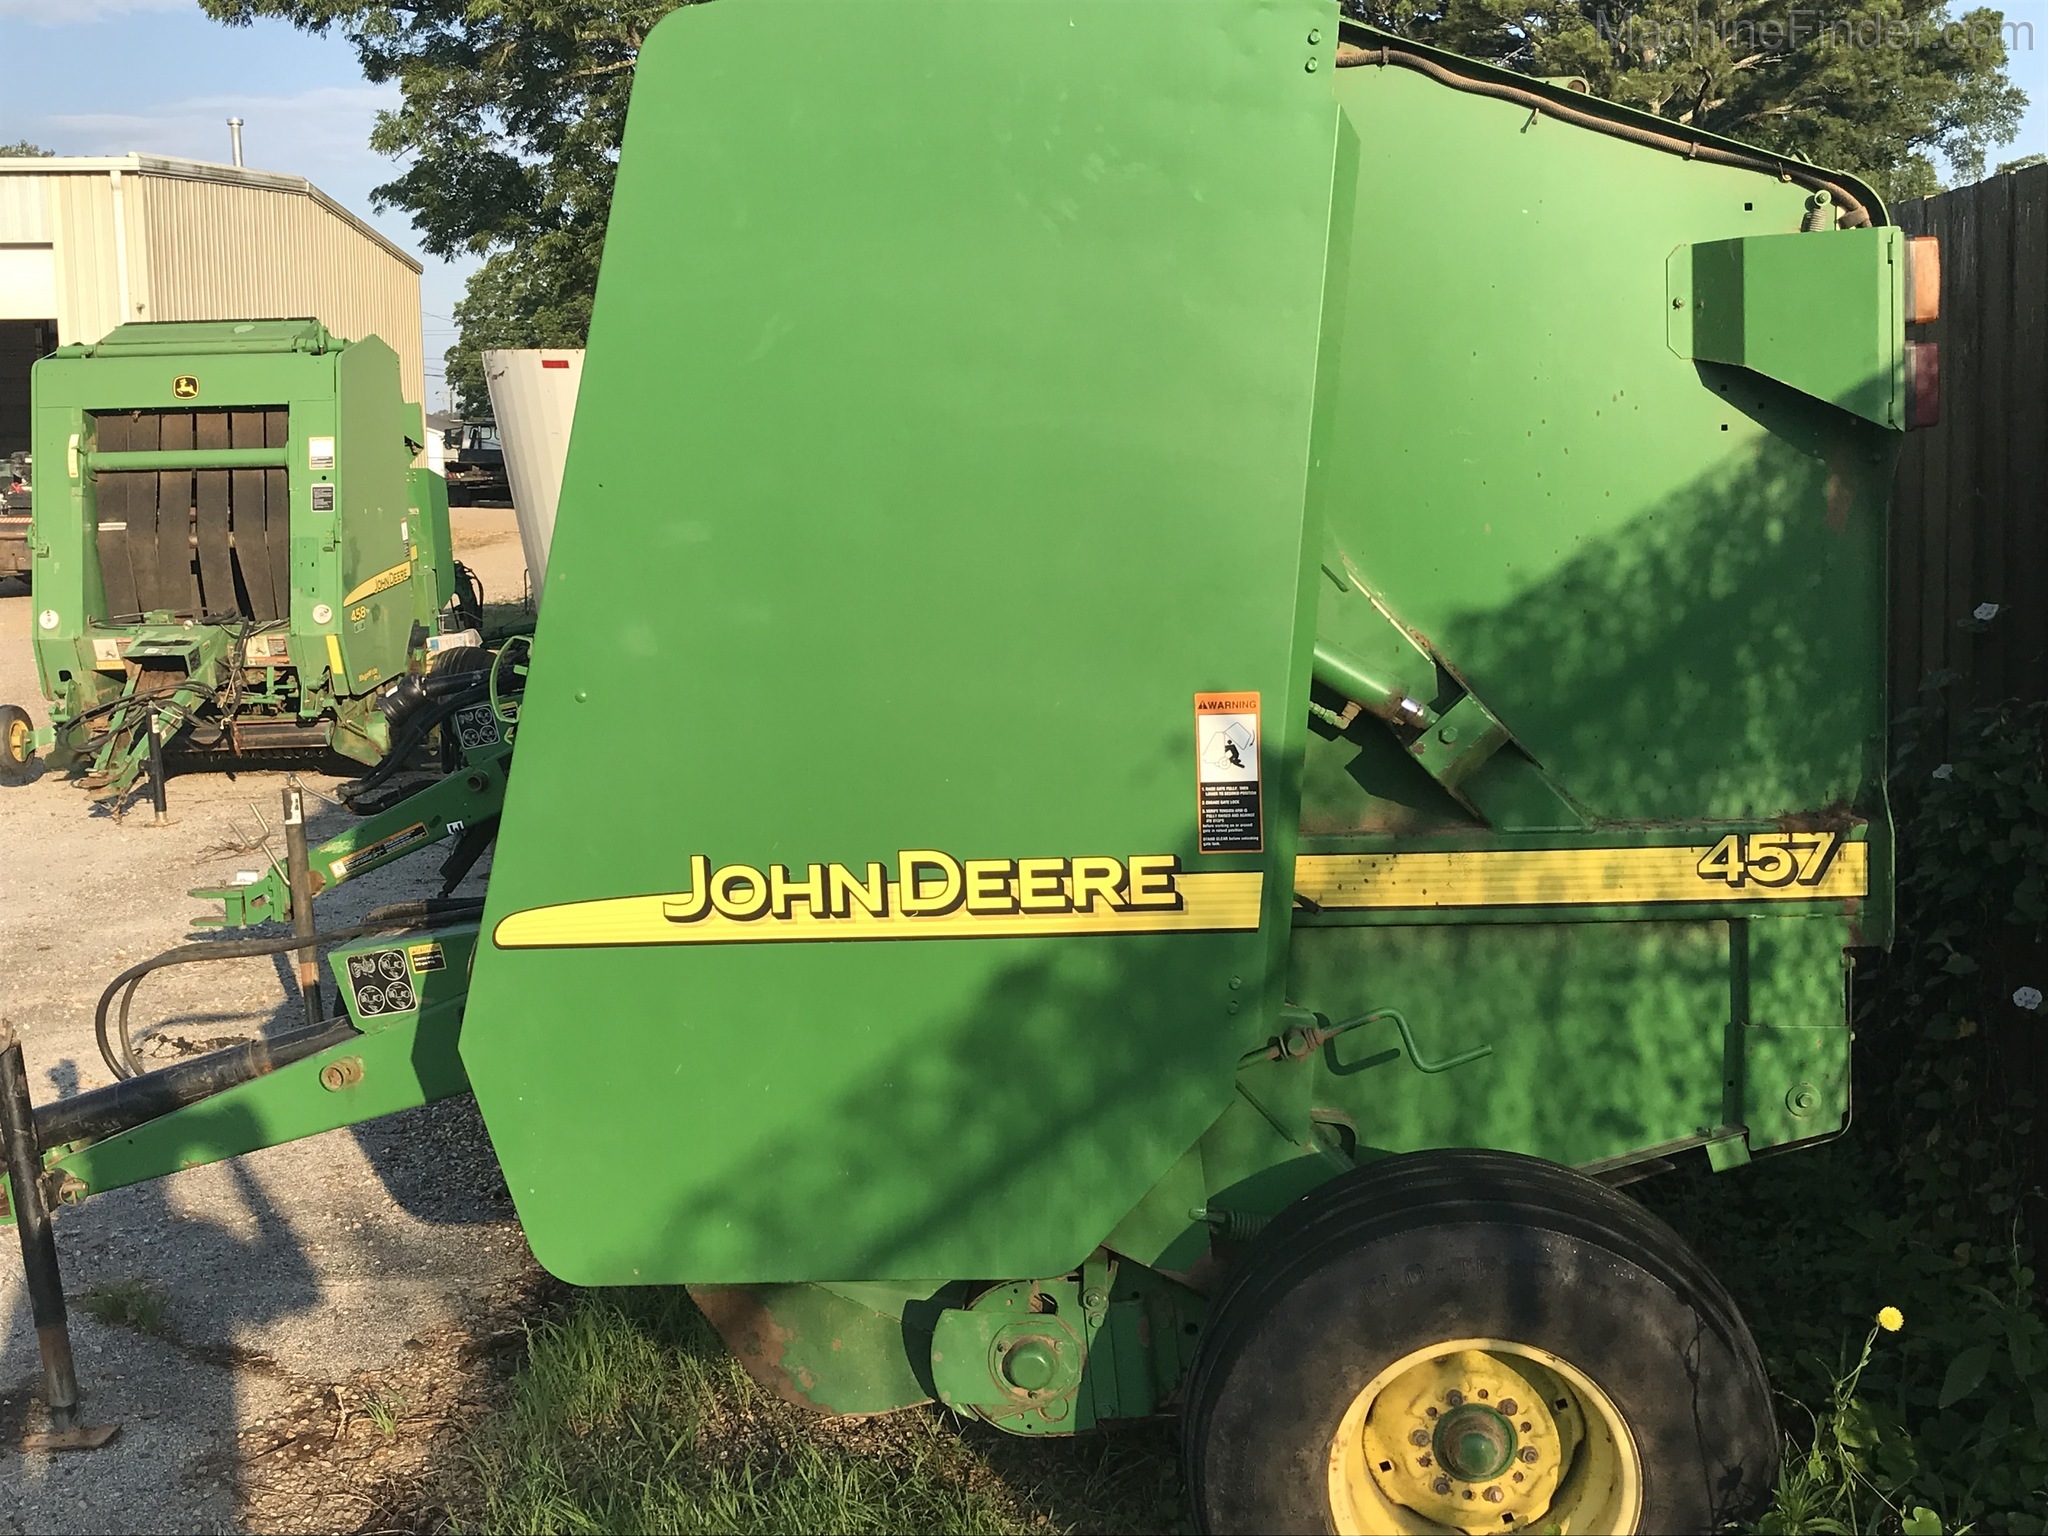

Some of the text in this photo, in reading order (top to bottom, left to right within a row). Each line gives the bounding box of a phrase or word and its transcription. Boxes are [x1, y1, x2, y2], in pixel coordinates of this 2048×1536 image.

[351, 606, 366, 622] 458
[1207, 700, 1257, 709] WARNING
[1697, 832, 1842, 887] 457
[663, 849, 1184, 923] JOHN DEERE
